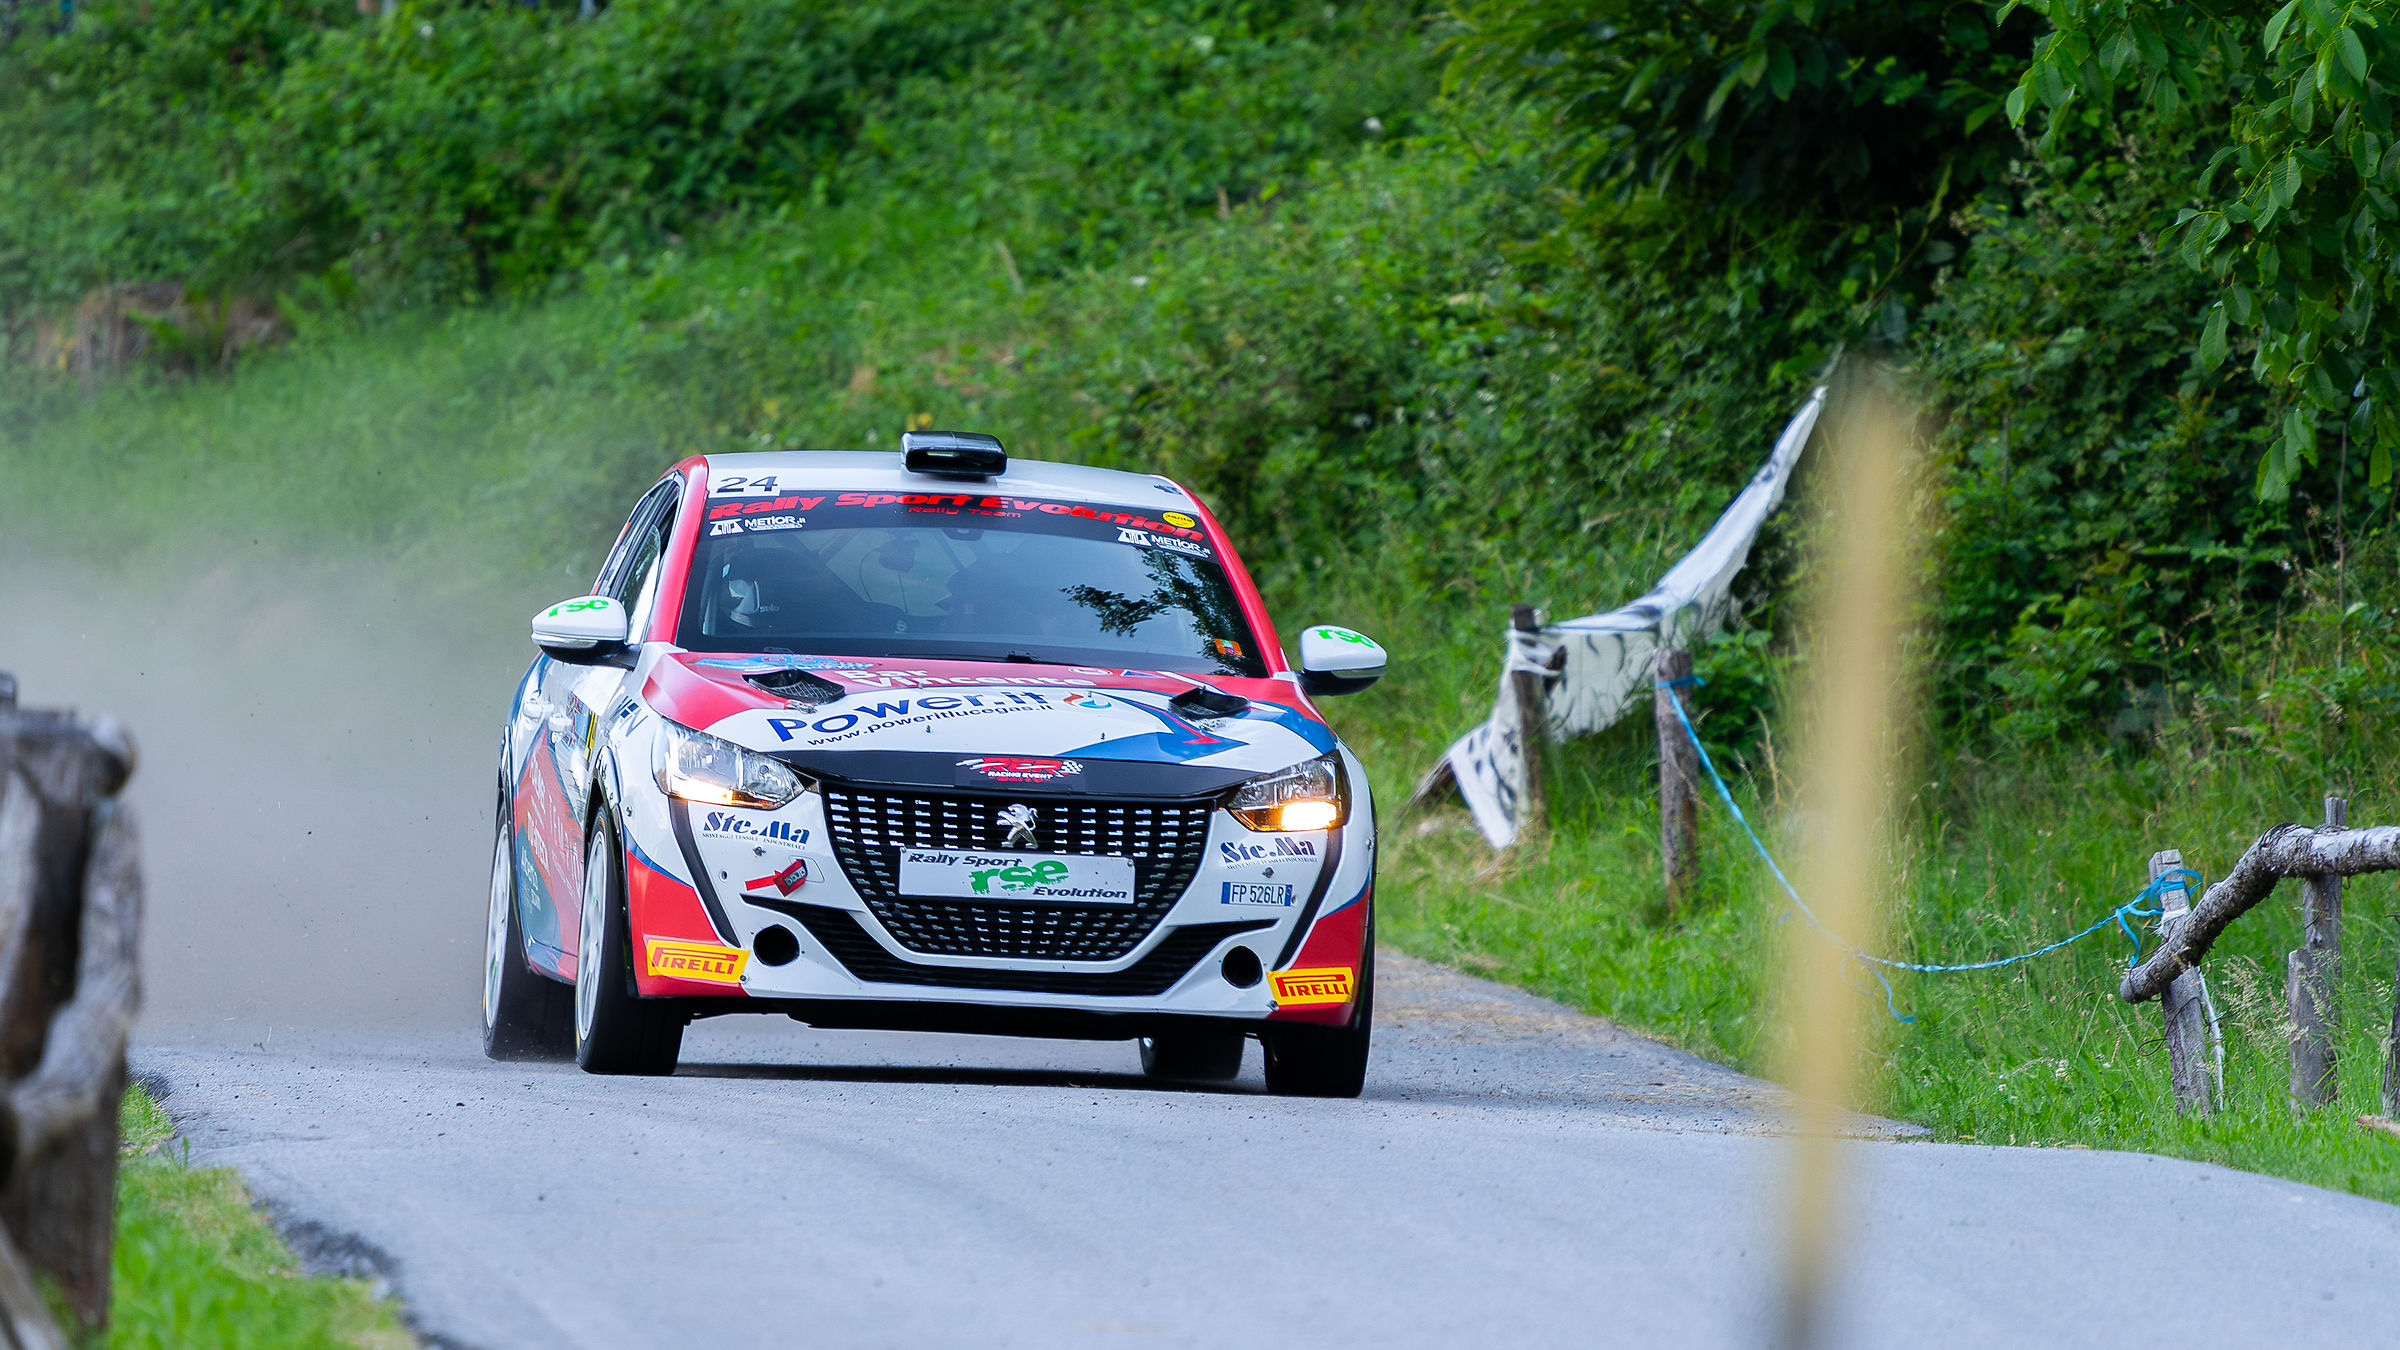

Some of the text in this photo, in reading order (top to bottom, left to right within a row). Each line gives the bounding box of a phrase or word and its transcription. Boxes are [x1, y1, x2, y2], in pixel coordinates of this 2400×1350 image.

[716, 476, 778, 493] 24
[709, 492, 1204, 542] Rally Sport Evolution
[767, 690, 1047, 742] Power.it
[808, 704, 1055, 746] www.poweritlucegas.it
[907, 852, 1023, 868] Rally Sport
[968, 860, 1069, 895] rse
[1032, 886, 1128, 899] Evolution
[1231, 884, 1285, 905] FP 526LR
[651, 946, 739, 975] PIRELLI
[1274, 973, 1350, 998] PIRELLI
